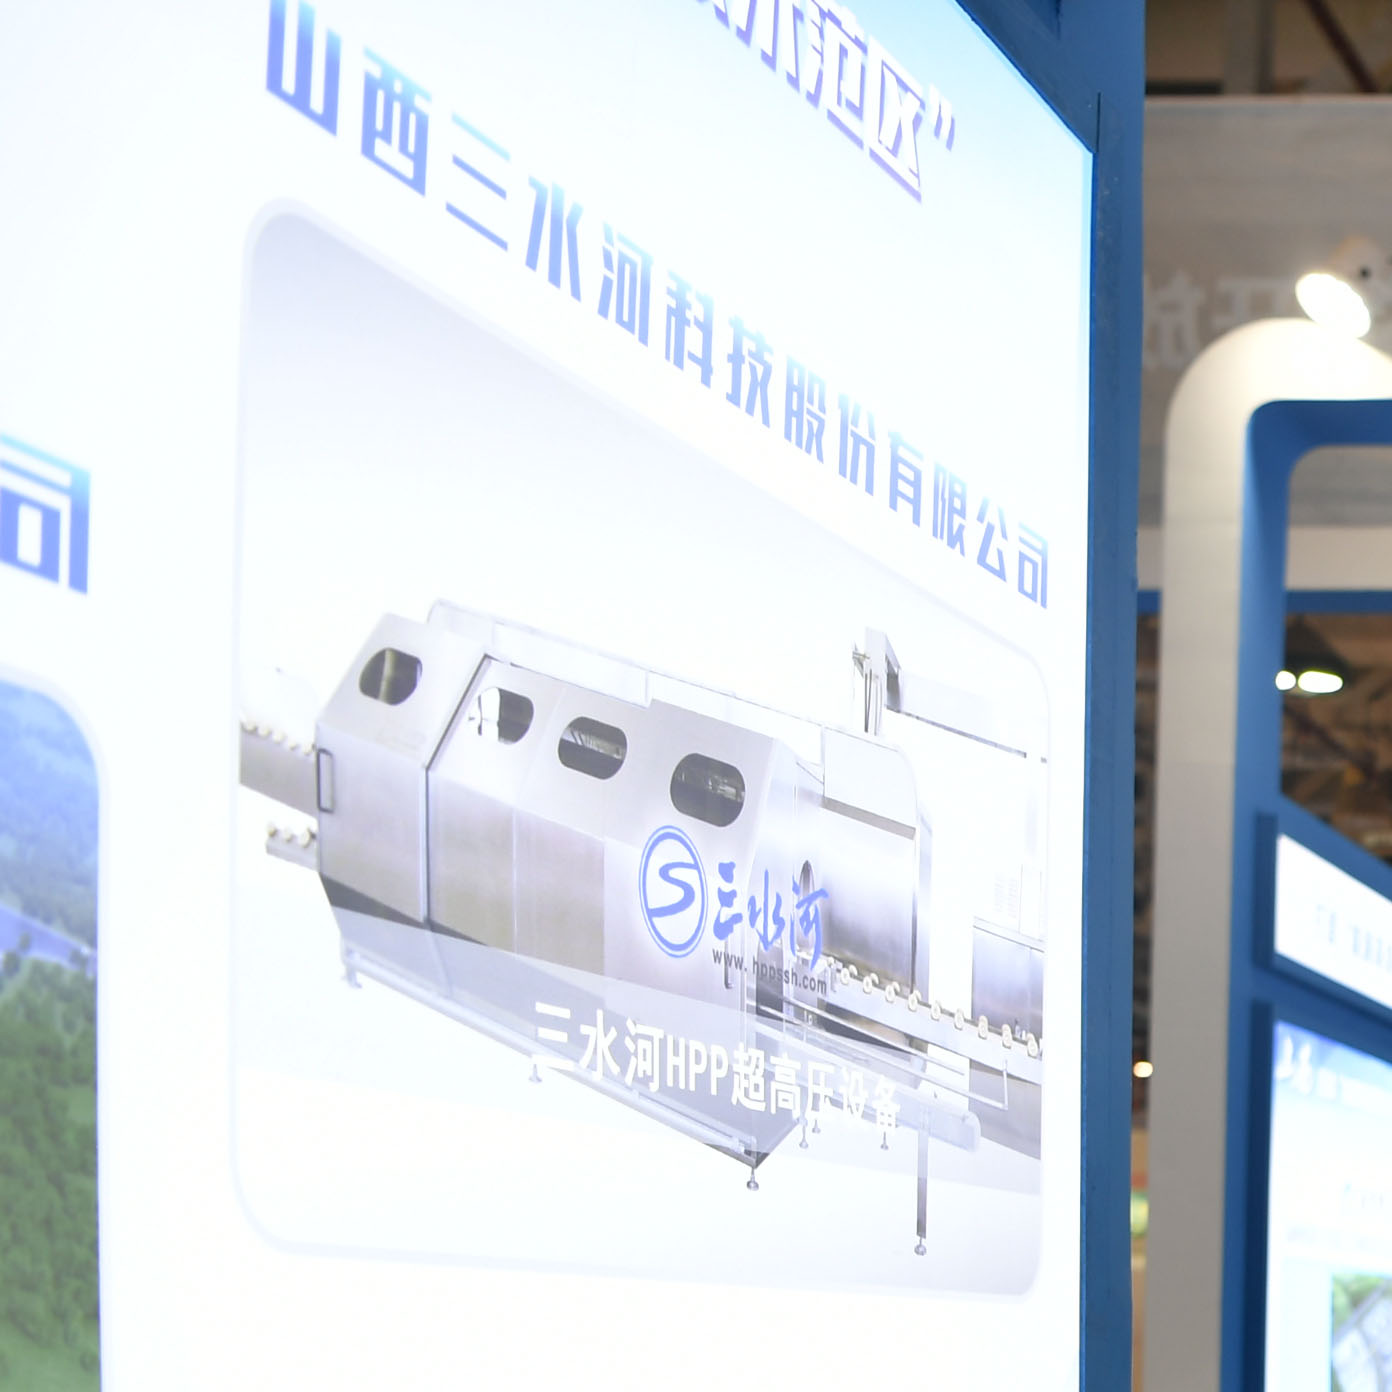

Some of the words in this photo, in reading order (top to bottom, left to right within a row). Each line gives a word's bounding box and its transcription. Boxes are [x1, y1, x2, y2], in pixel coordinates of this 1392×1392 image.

[265, 0, 1050, 610] 山西三水河科技股份有限公司
[531, 1001, 902, 1132] 三水河HPP超高压设备
